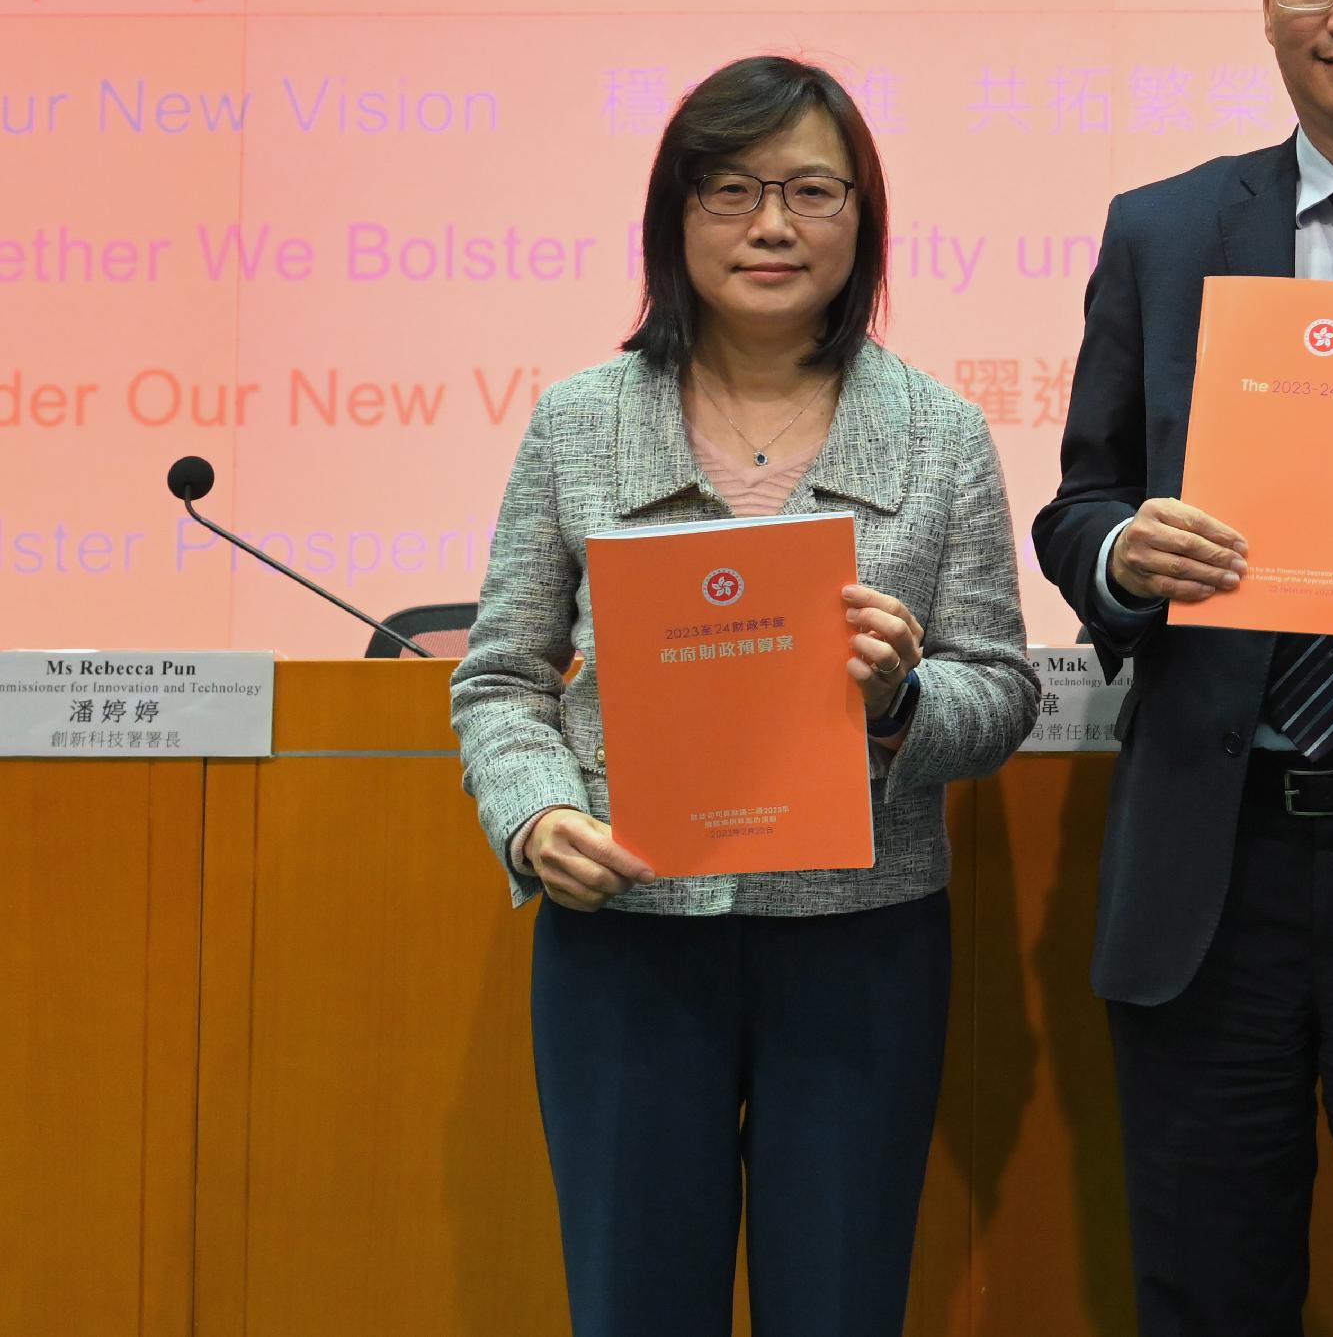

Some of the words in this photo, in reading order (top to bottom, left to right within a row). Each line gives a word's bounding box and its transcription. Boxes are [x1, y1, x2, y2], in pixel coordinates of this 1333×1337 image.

[101, 77, 253, 134] New
[282, 76, 500, 133] Vision
[198, 224, 315, 282] We
[347, 223, 595, 281] Bolster
[1241, 377, 1269, 393] The
[127, 368, 259, 427] Our
[289, 368, 446, 426] New
[659, 634, 794, 664] 政府財政預算案
[46, 660, 73, 676] Ms
[80, 659, 154, 676] Rebecca
[162, 660, 196, 676] Pun
[1047, 657, 1088, 672] Mak
[70, 681, 89, 693] for
[93, 682, 159, 694] Innovation
[164, 682, 185, 694] and
[190, 682, 262, 696] Technology
[1049, 677, 1102, 688] Technology
[69, 699, 160, 724] 潘婷婷
[51, 730, 182, 749] 創新科技署署長
